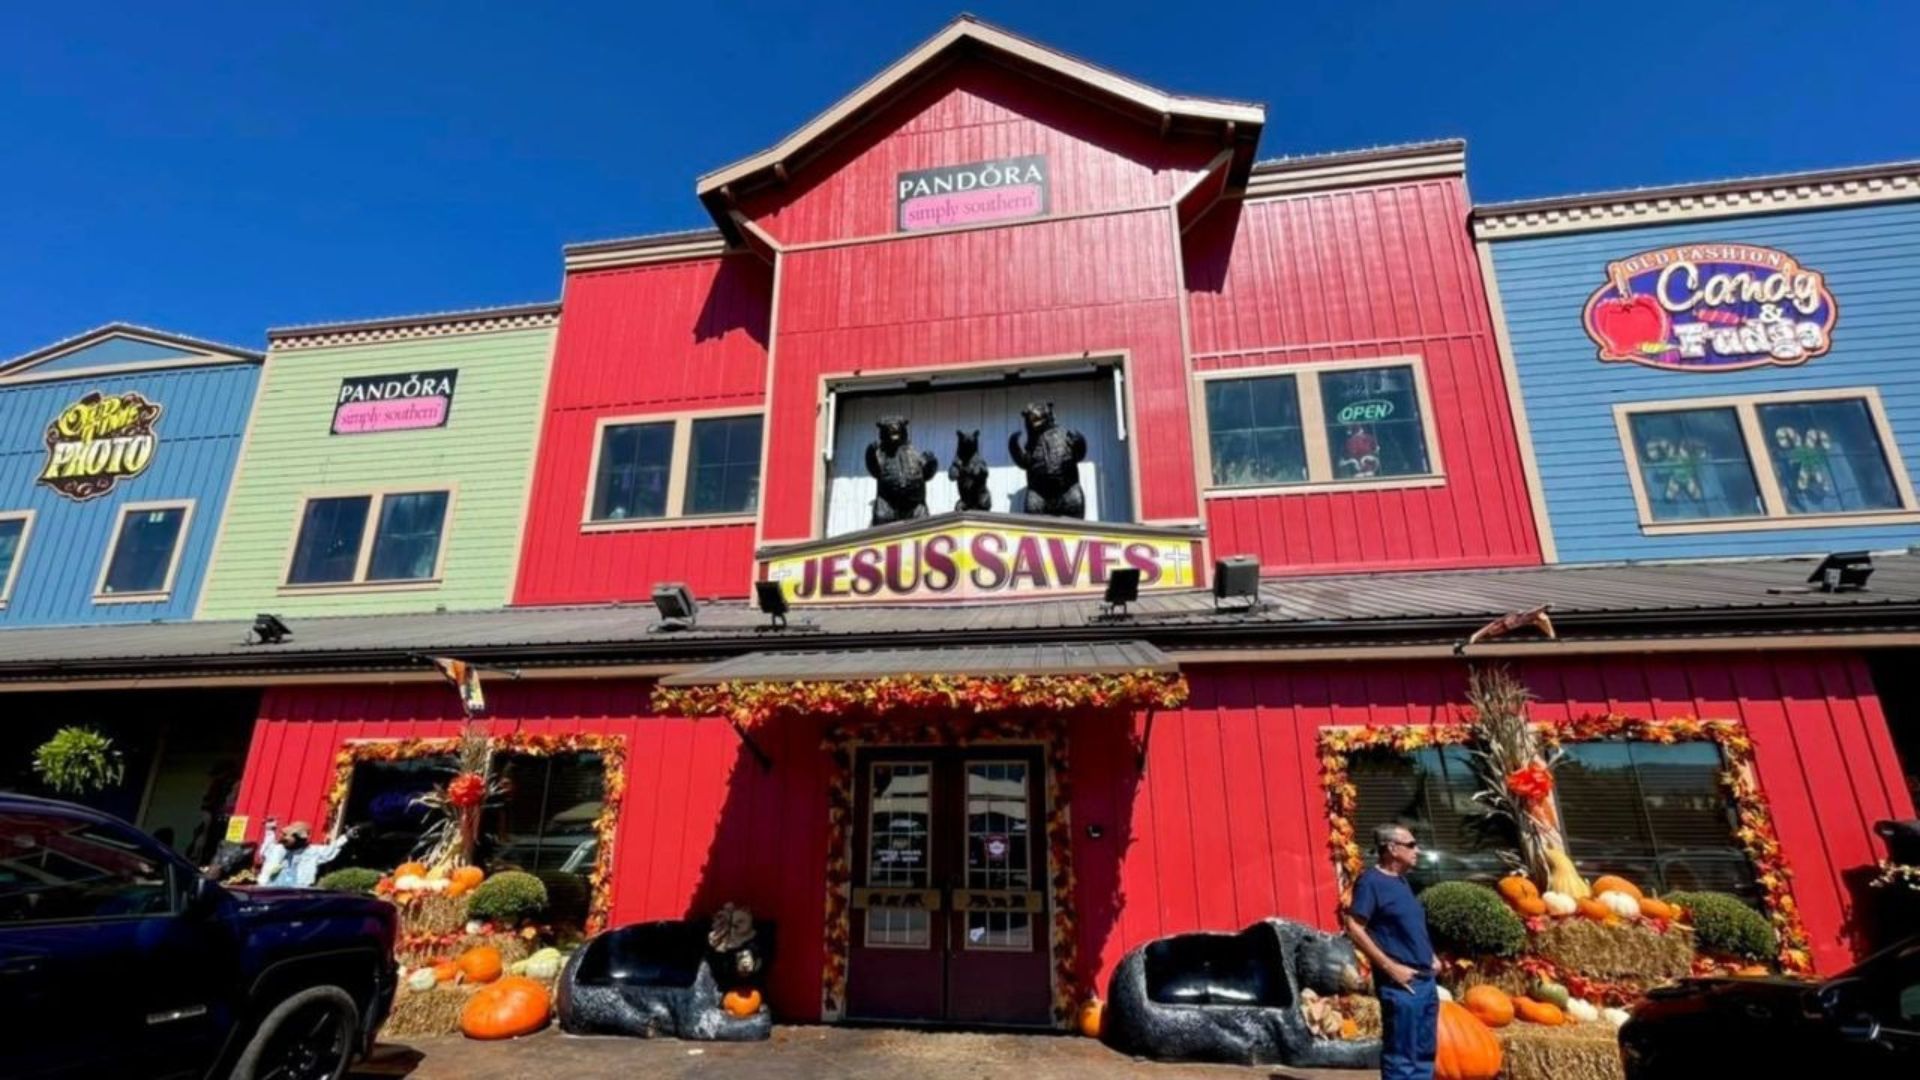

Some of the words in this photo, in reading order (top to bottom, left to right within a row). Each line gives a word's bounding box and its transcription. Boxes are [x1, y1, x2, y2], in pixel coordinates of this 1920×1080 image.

[909, 200, 959, 224] simply
[963, 193, 1034, 216] southern
[1626, 252, 1669, 273] OLD
[1677, 247, 1781, 266] FASHION
[1657, 262, 1819, 314] Candy
[1759, 304, 1783, 322] &
[1673, 319, 1824, 358] Fudge
[341, 406, 378, 430] simply
[384, 402, 438, 420] southern
[1341, 404, 1388, 421] OPEN
[45, 435, 153, 479] PHOTO
[793, 534, 960, 599] JESUS
[970, 532, 1163, 591] SAVES
